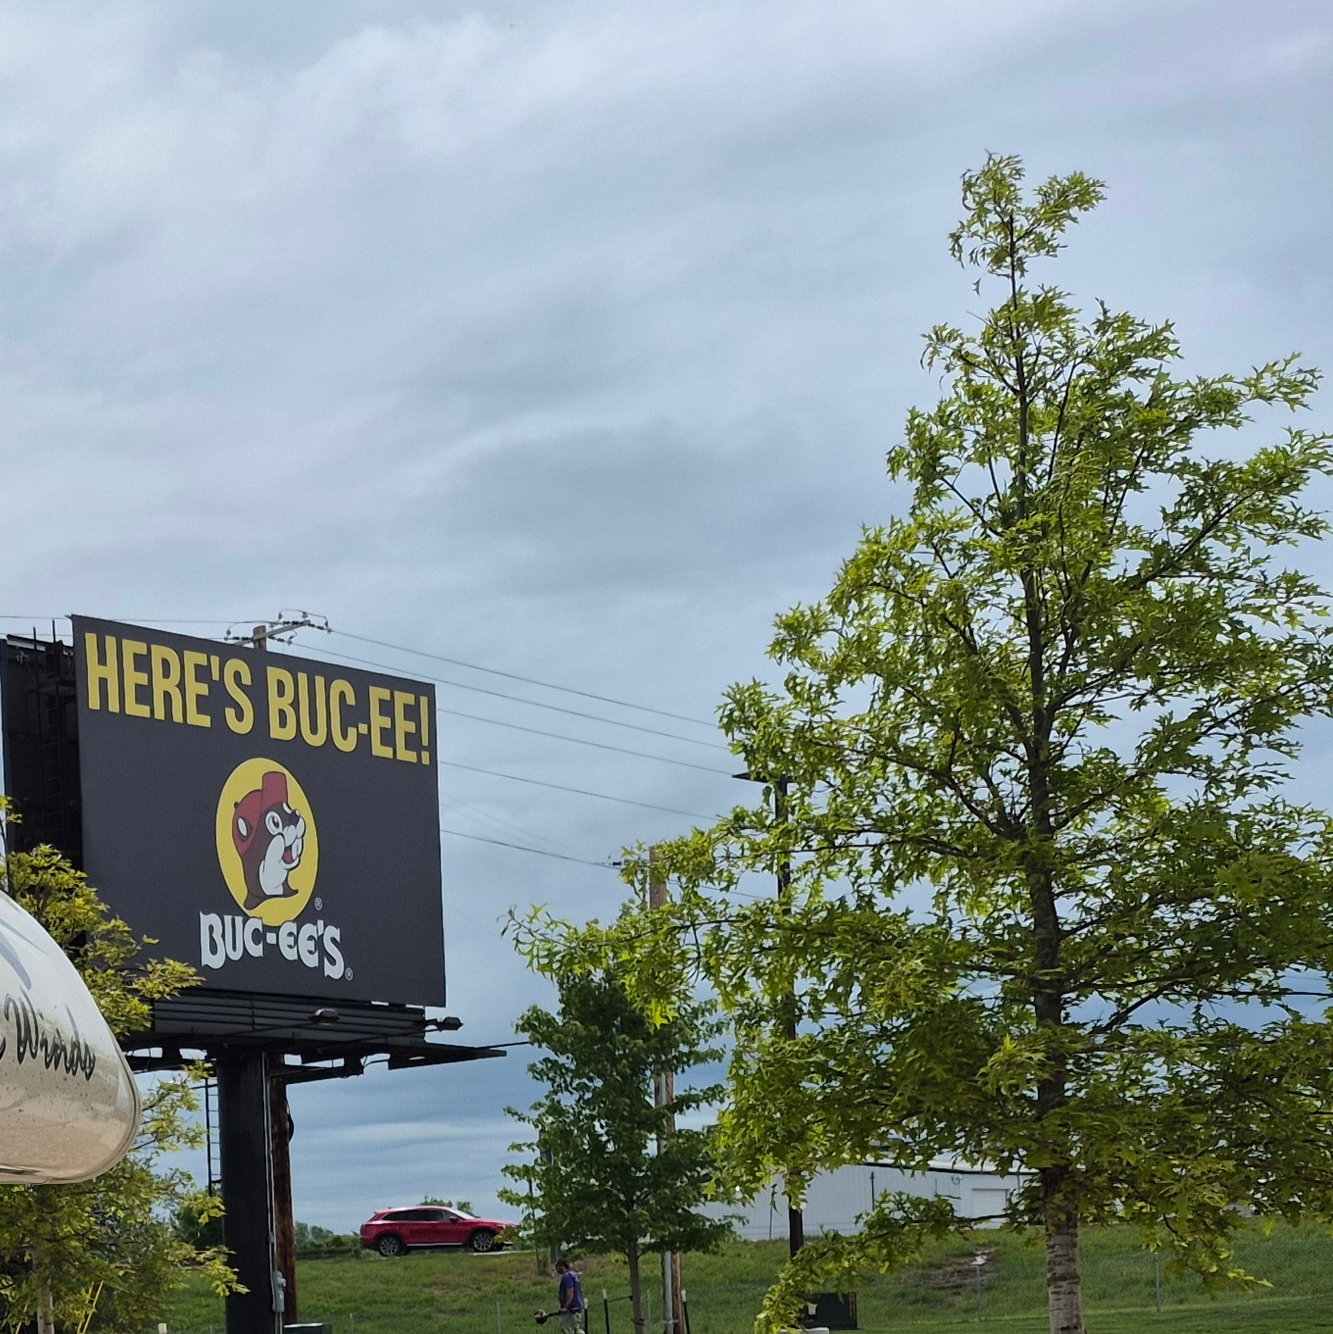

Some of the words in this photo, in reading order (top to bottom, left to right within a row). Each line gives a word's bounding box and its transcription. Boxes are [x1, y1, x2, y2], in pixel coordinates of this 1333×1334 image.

[85, 632, 254, 735] HERE'S
[266, 666, 430, 766] BUC-EE!
[200, 911, 345, 980] BUC-EE'S
[4, 986, 96, 1081] Winds
